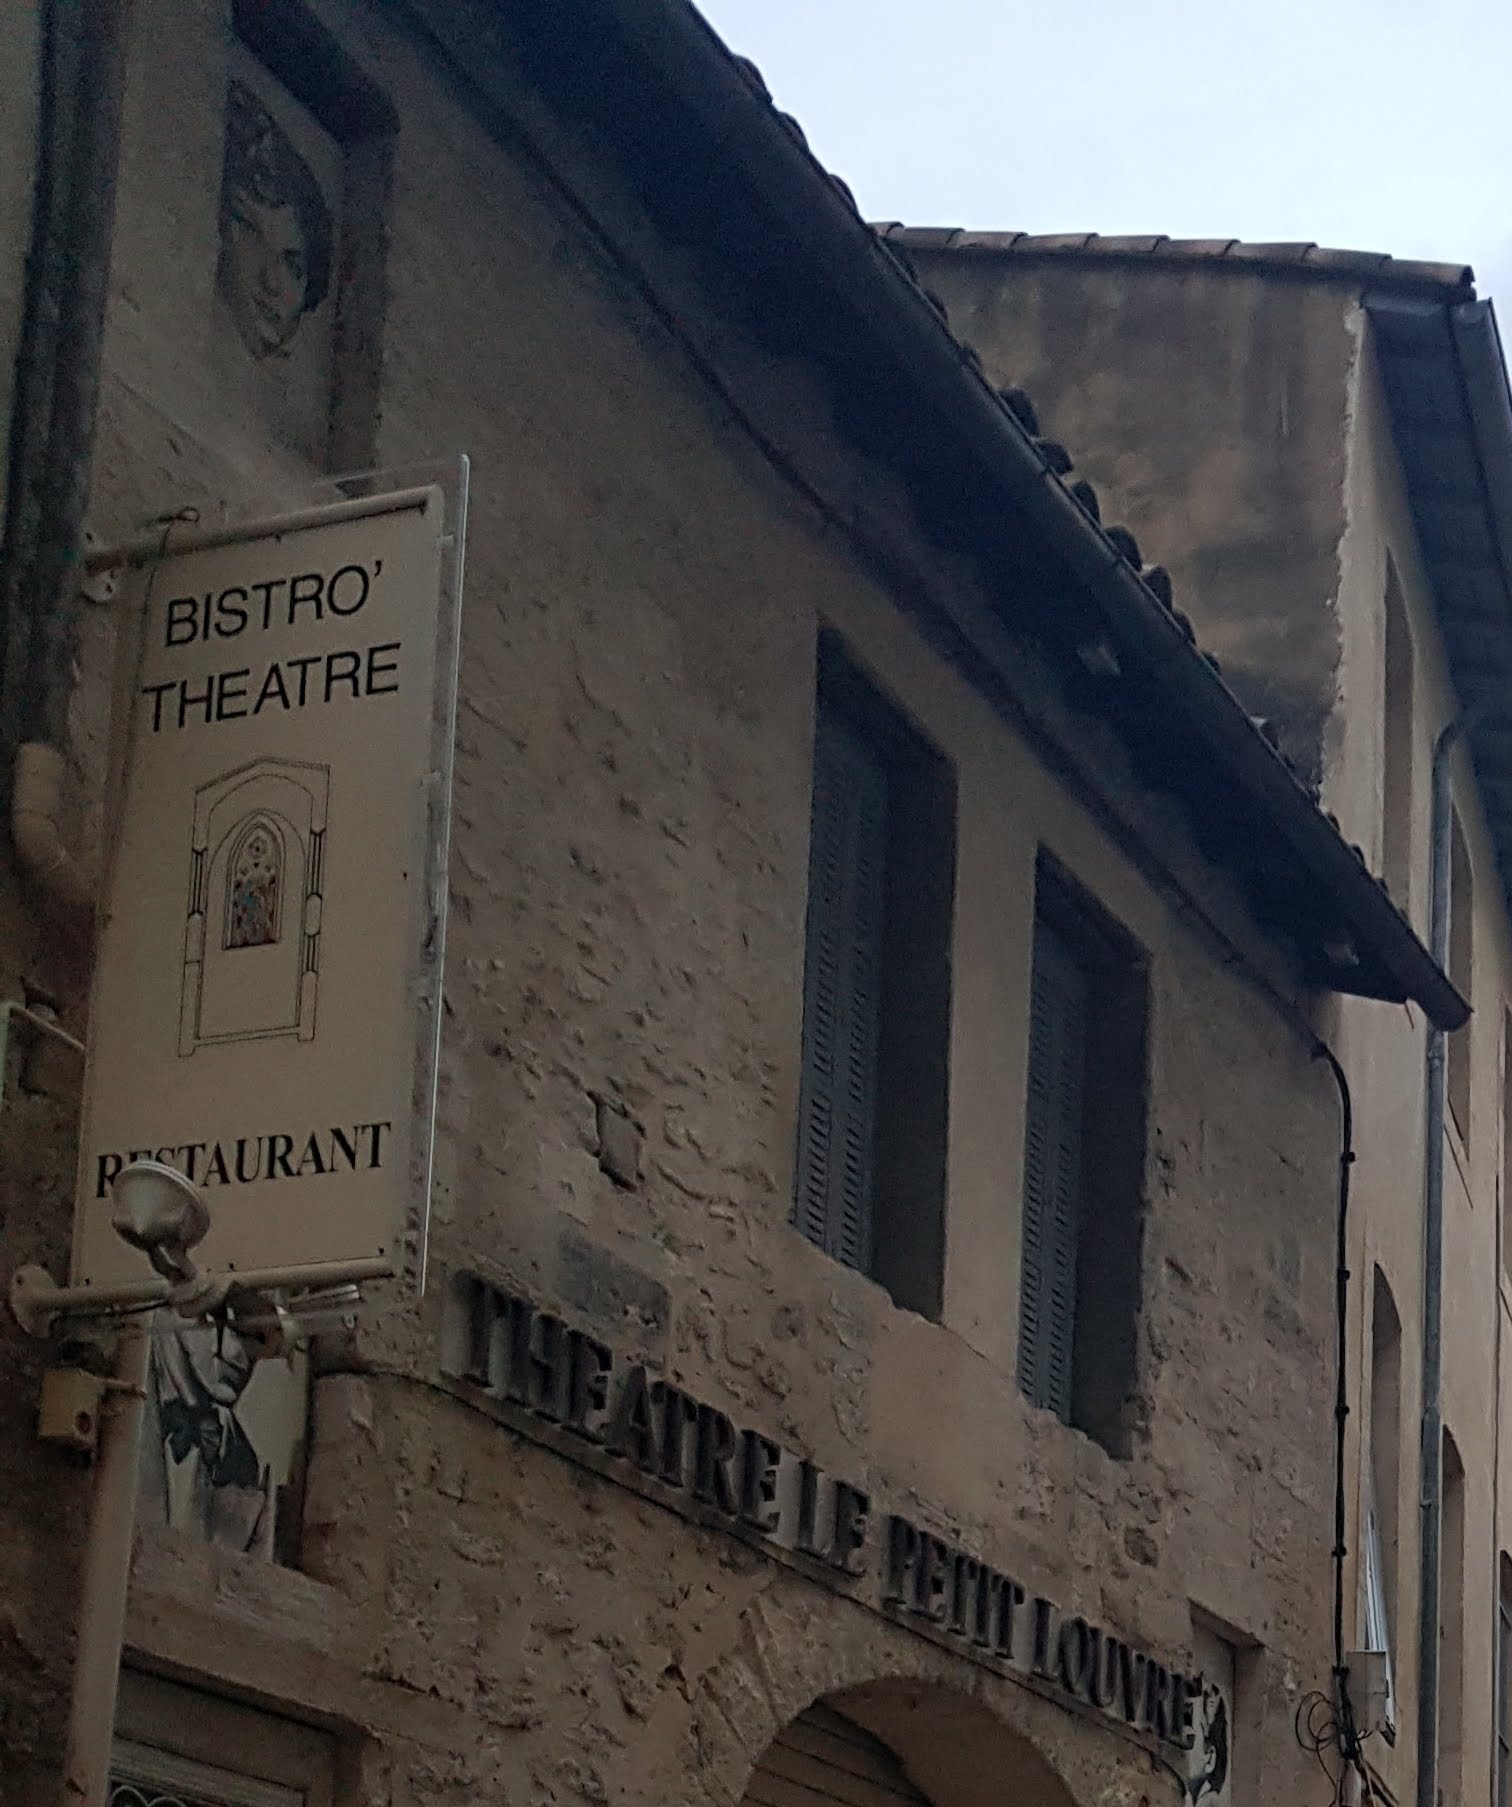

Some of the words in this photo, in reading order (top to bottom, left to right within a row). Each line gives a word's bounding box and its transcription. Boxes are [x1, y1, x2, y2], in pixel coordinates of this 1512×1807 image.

[142, 642, 401, 733] THEATRE
[94, 1122, 391, 1198] RTAURANT
[442, 1270, 782, 1535] THEATRE
[795, 1460, 869, 1579] LE
[880, 1515, 1025, 1660] PETIT
[1031, 1598, 1203, 1751] LOUVRE
